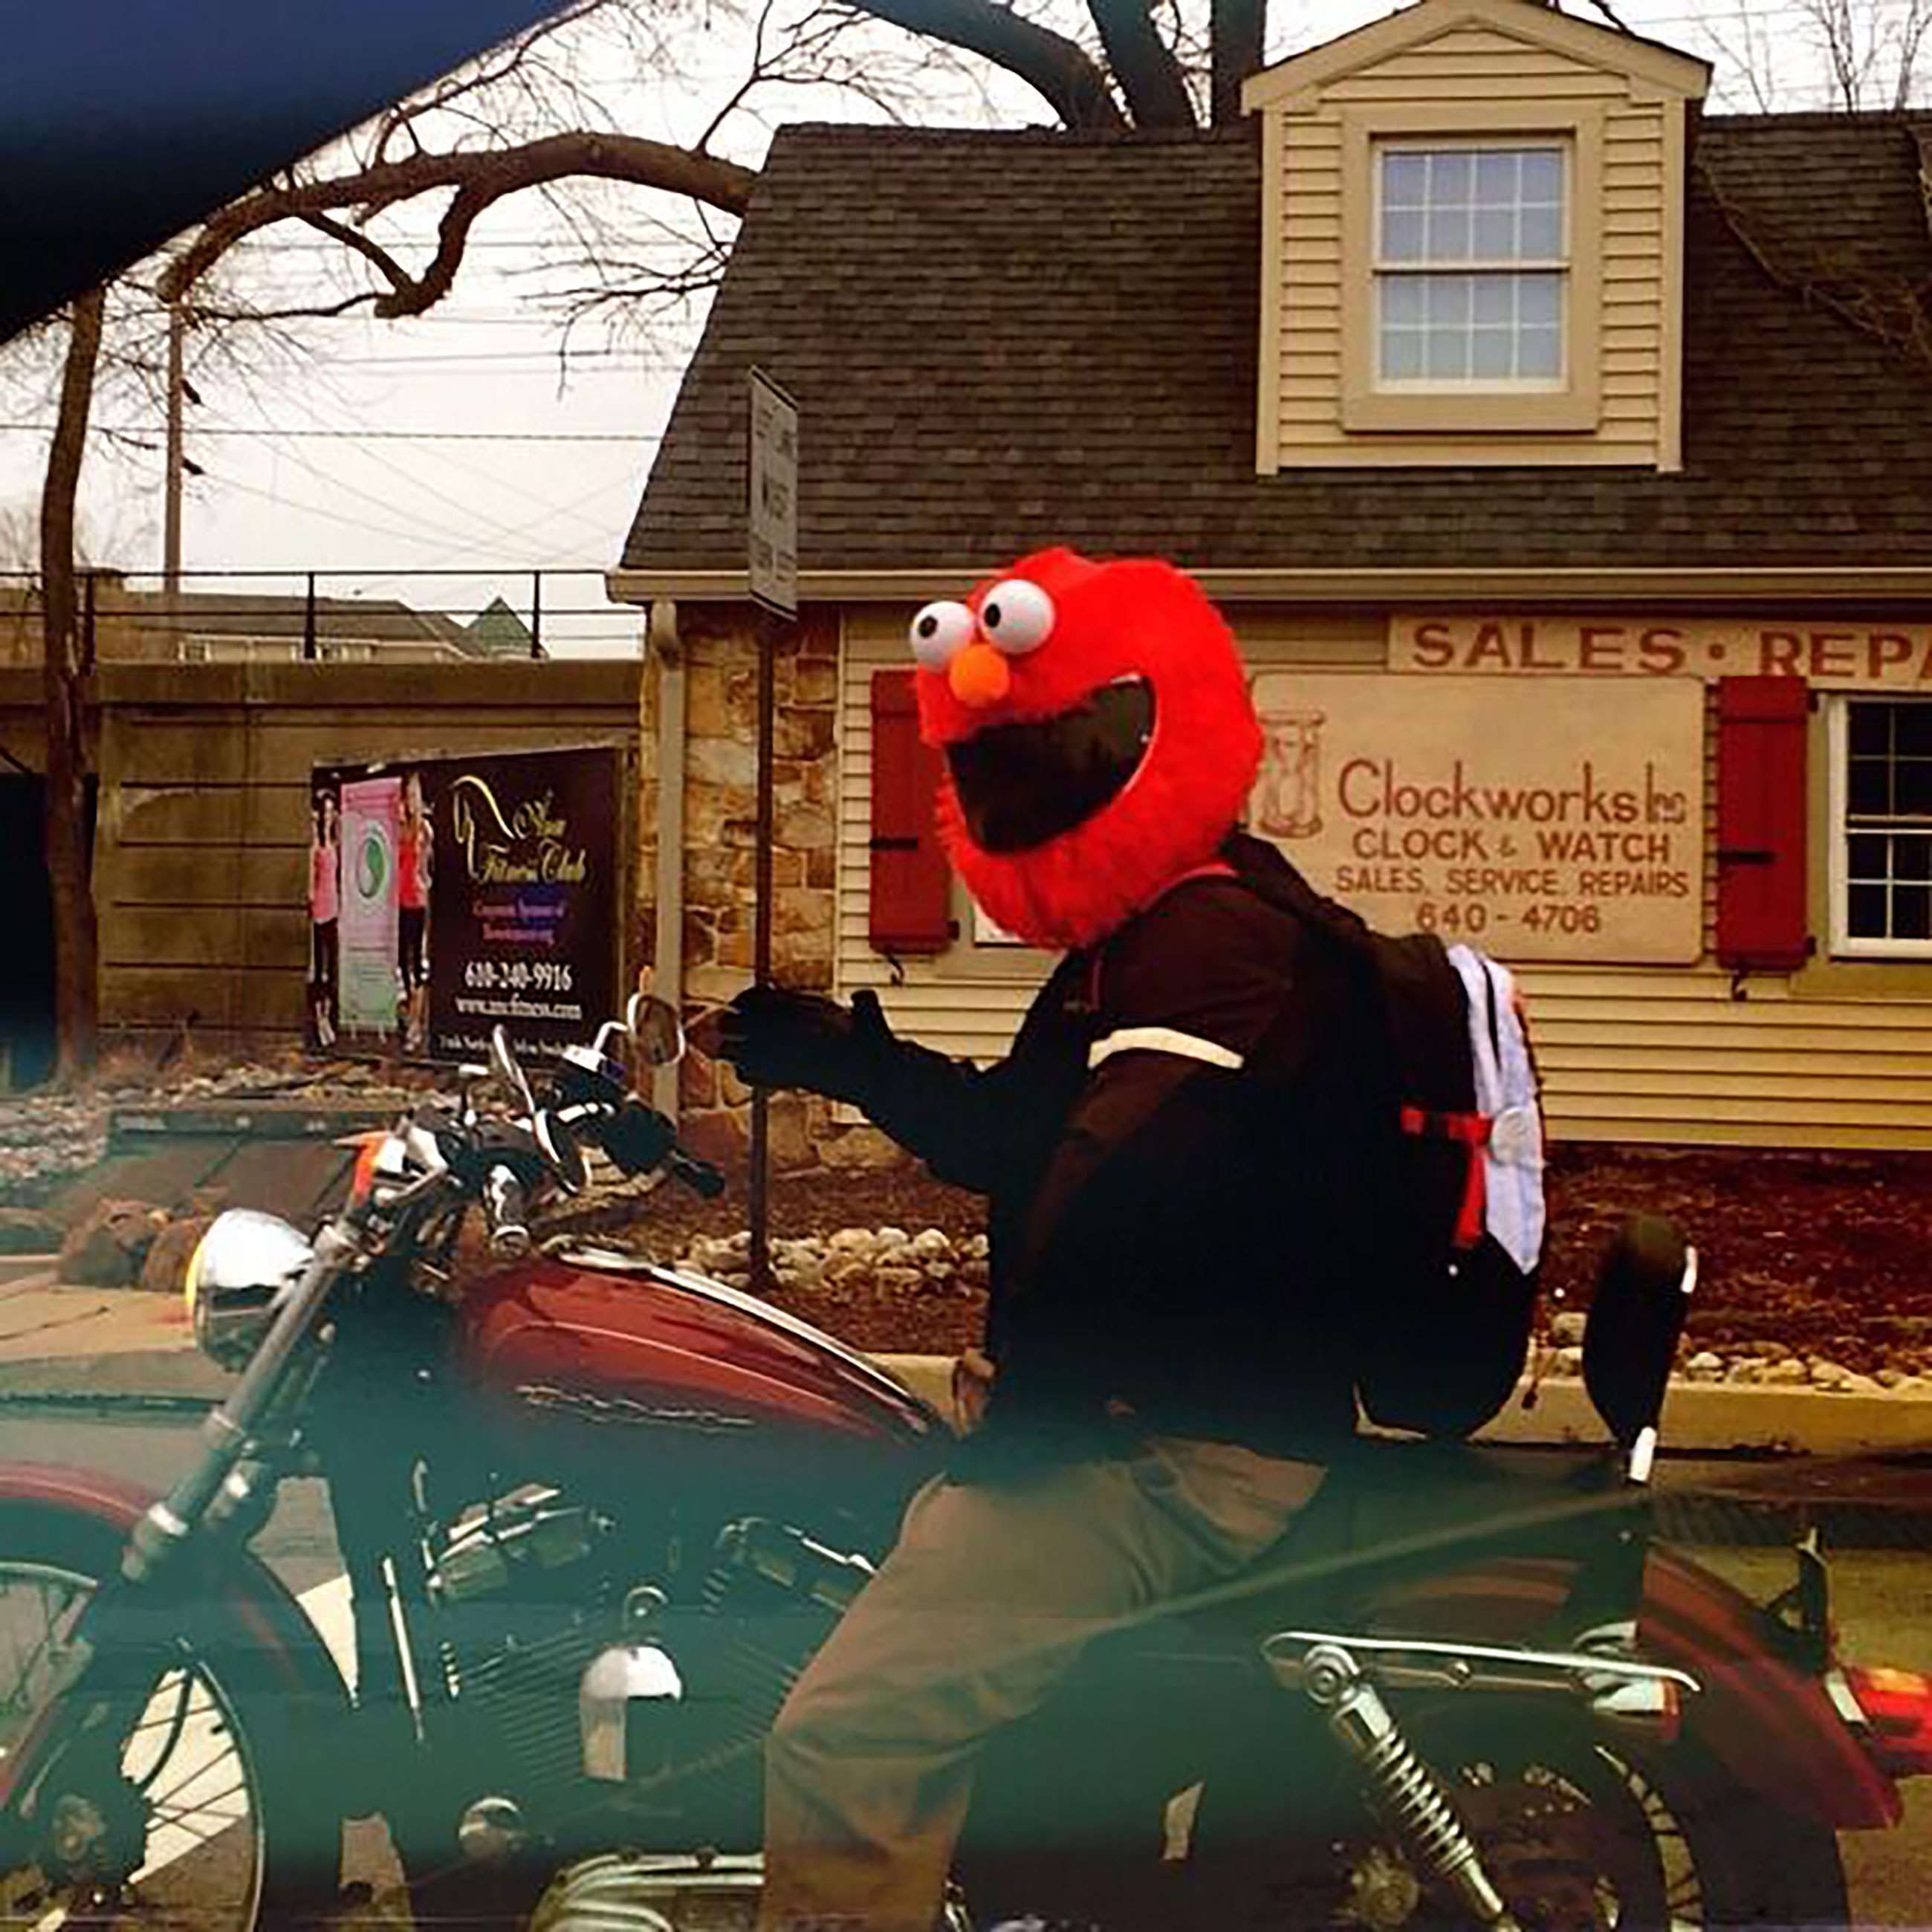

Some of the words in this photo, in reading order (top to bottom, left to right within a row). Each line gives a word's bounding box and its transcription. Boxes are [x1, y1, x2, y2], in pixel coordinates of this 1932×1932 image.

[1413, 622, 1687, 675] SALES
[1338, 758, 1639, 824] Clockworks
[1352, 828, 1489, 862] CLOCK
[1497, 834, 1517, 858] &
[1535, 830, 1670, 863] WATCH
[1579, 870, 1690, 898] REPAIRS
